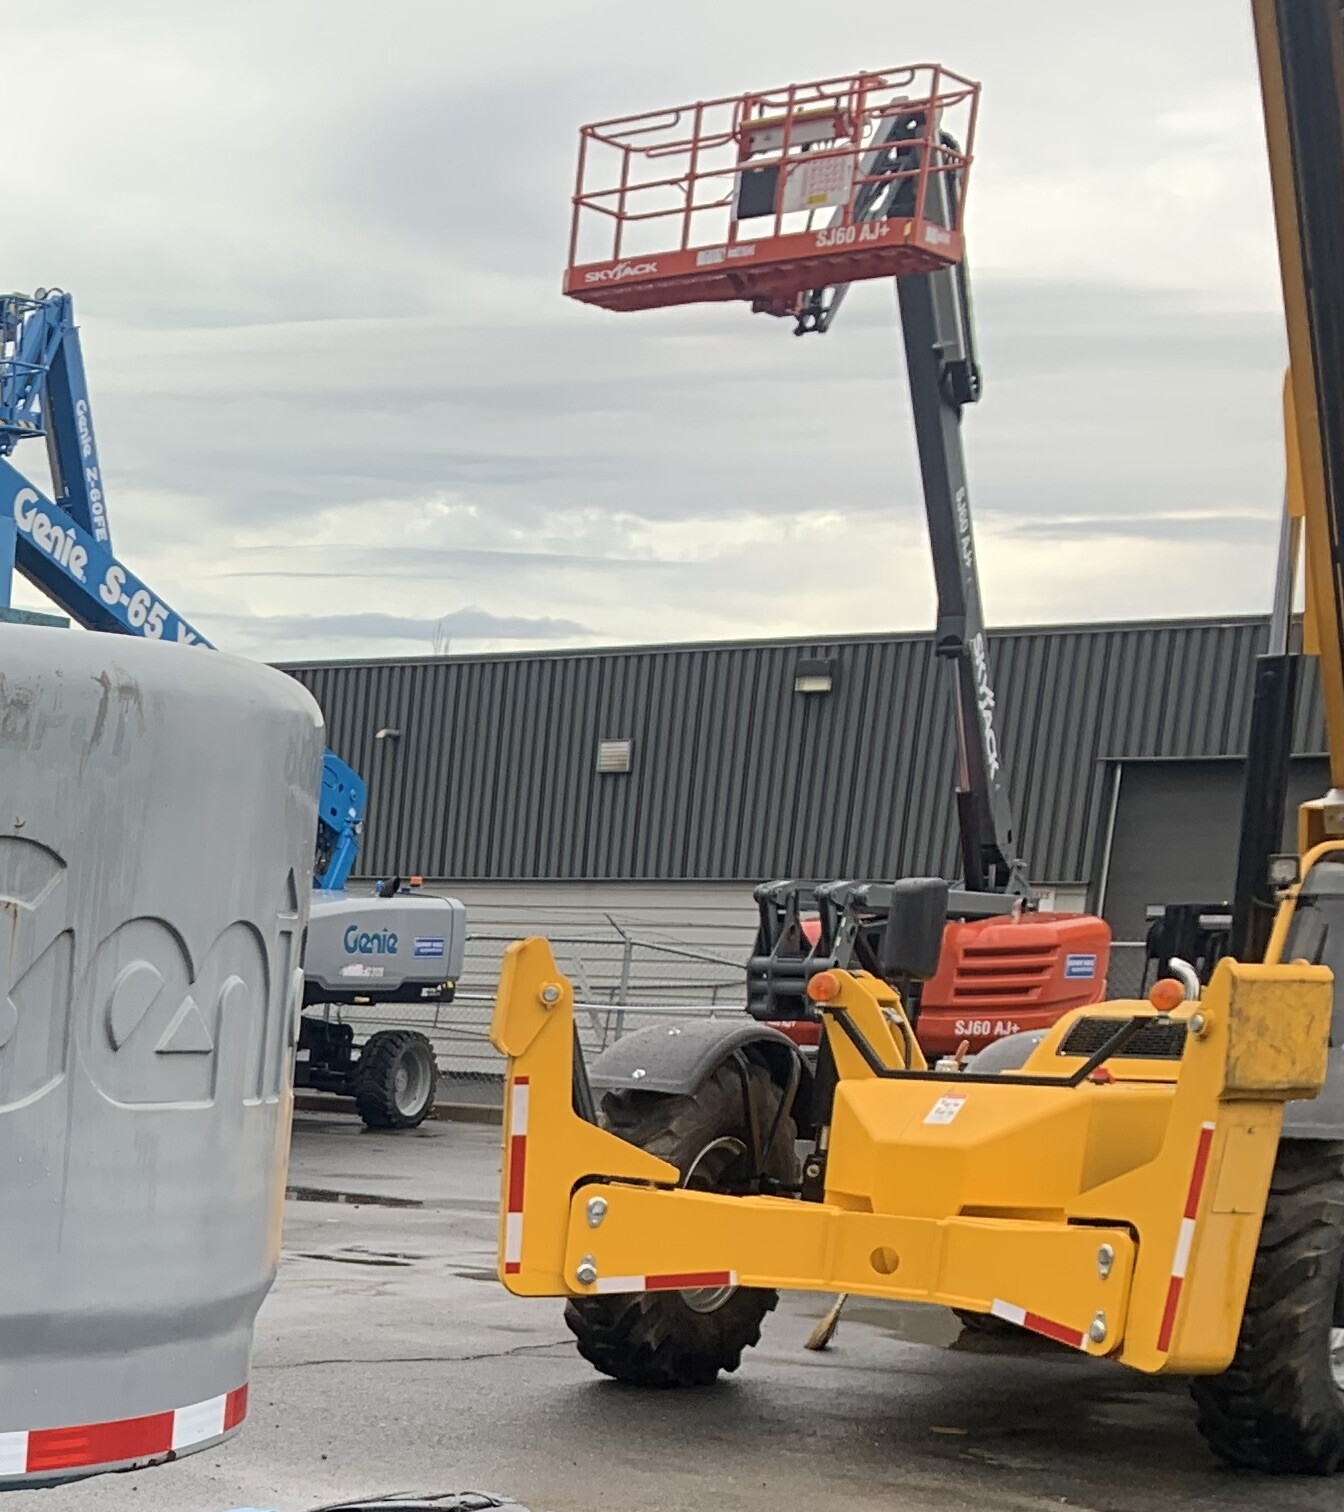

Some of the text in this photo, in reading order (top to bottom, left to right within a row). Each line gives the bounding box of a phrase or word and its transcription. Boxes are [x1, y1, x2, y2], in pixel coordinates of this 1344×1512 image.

[816, 219, 890, 248] SJ60 AJ+
[585, 259, 657, 283] SKYJACK
[74, 399, 92, 459] Genie
[14, 487, 89, 581] Genie
[100, 565, 169, 640] S-65
[344, 924, 398, 954] Genie
[954, 1019, 1020, 1036] SJ60 AJ+
